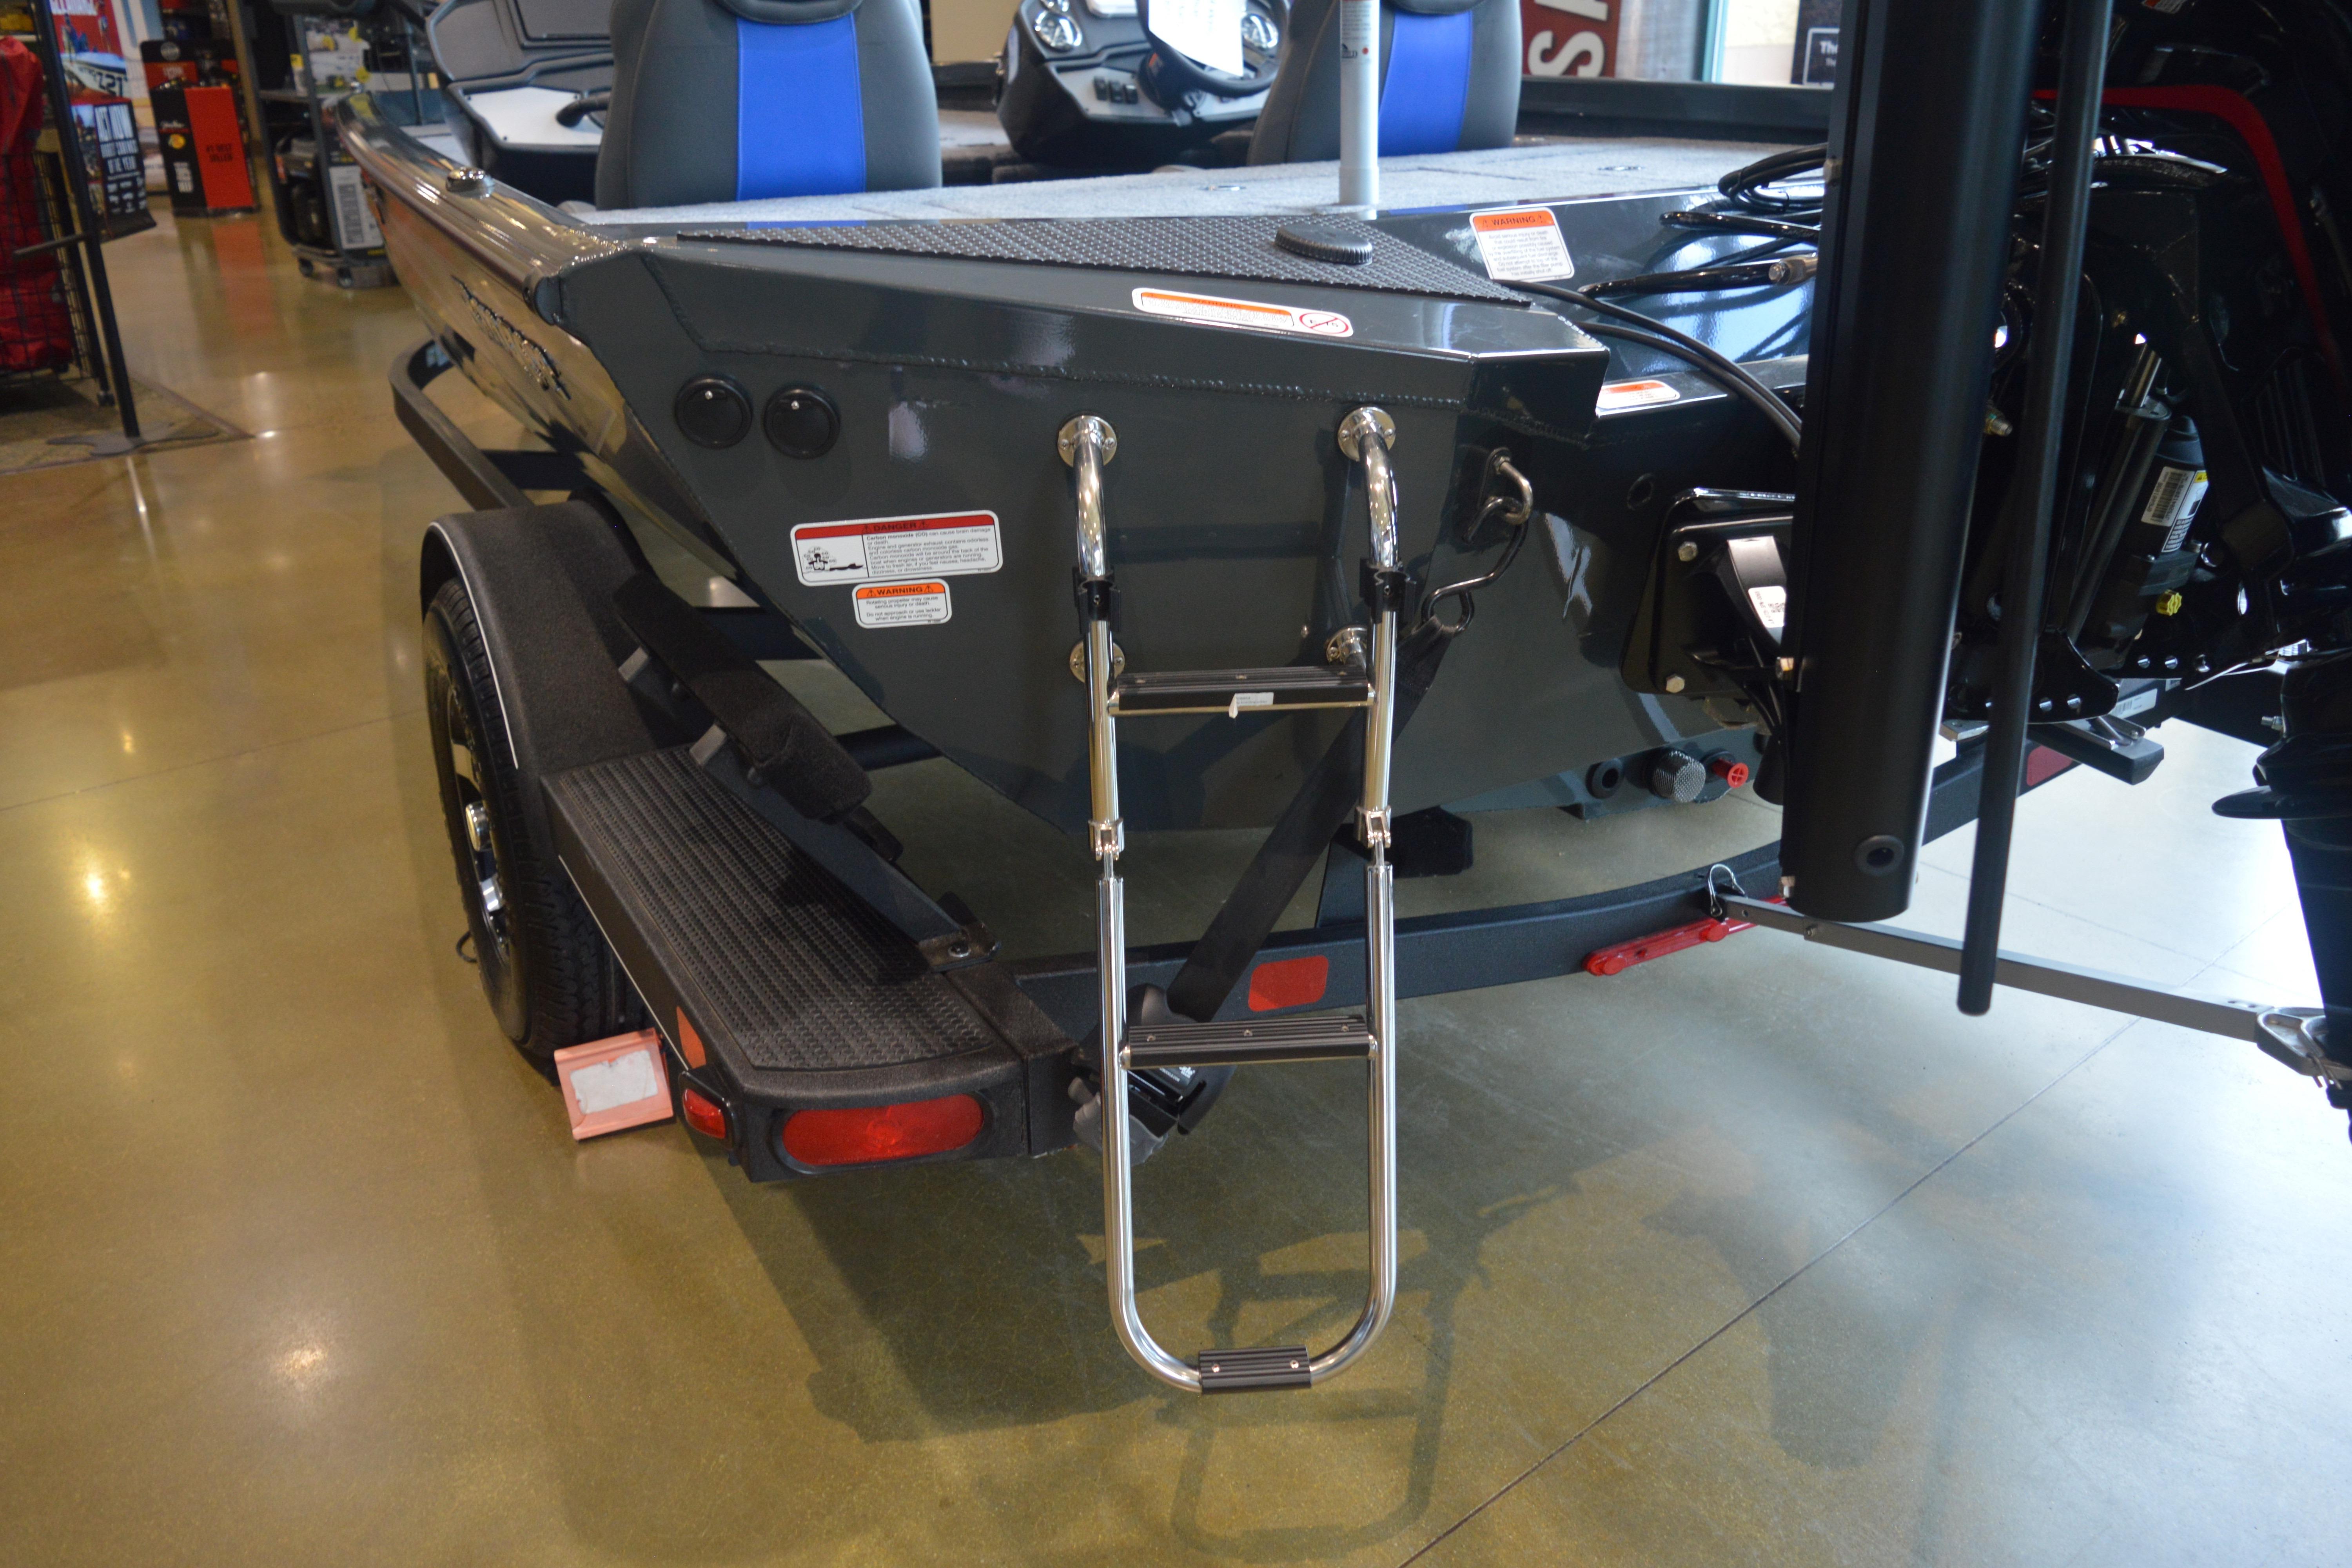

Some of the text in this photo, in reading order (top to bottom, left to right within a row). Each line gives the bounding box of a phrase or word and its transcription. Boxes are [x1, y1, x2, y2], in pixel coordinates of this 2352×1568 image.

[1492, 216, 1535, 225] WARNING
[874, 523, 916, 531] DANGER
[877, 586, 922, 595] WARNING
